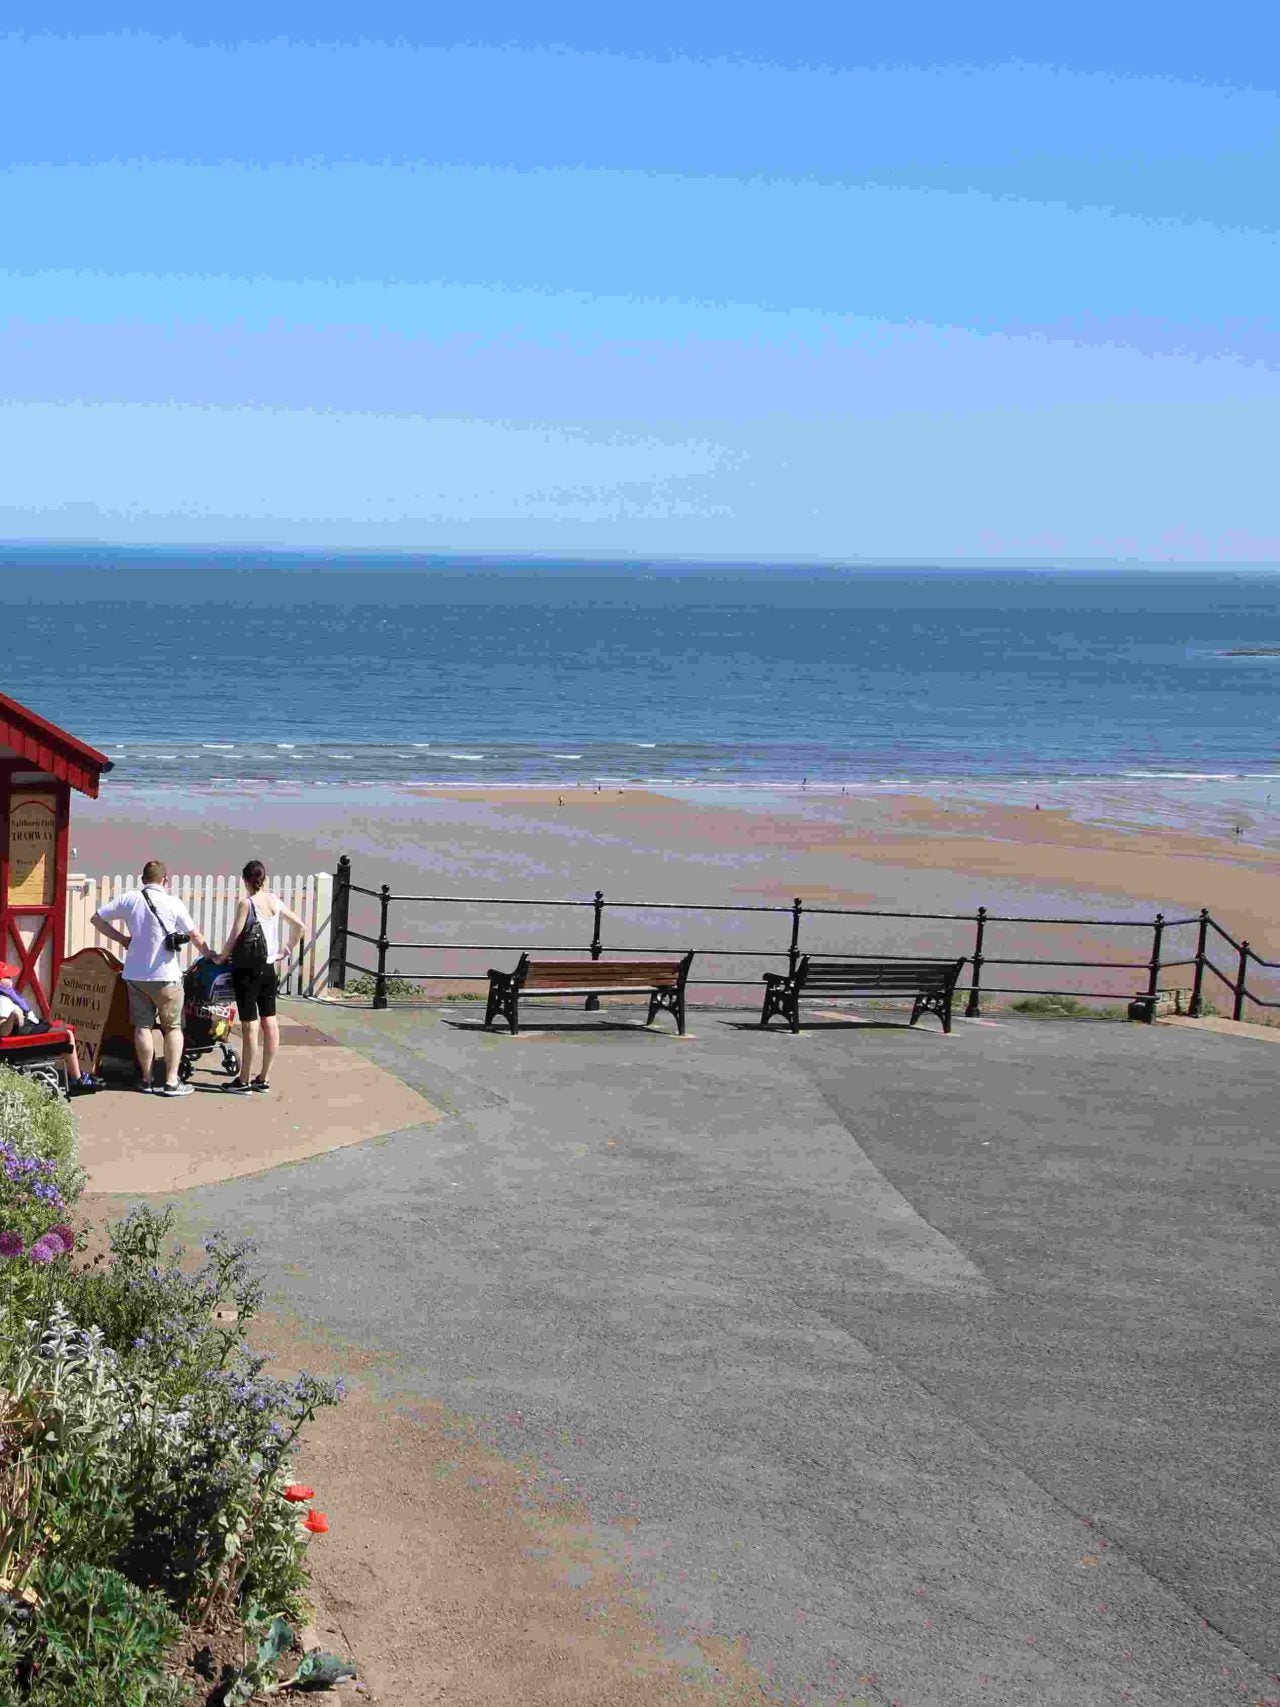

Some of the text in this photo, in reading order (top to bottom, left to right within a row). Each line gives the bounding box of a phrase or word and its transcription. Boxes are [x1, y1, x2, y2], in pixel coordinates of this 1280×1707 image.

[12, 832, 53, 840] TRAMWAY
[63, 979, 91, 992] Saltburn
[59, 993, 100, 1010] TRAMWAY
